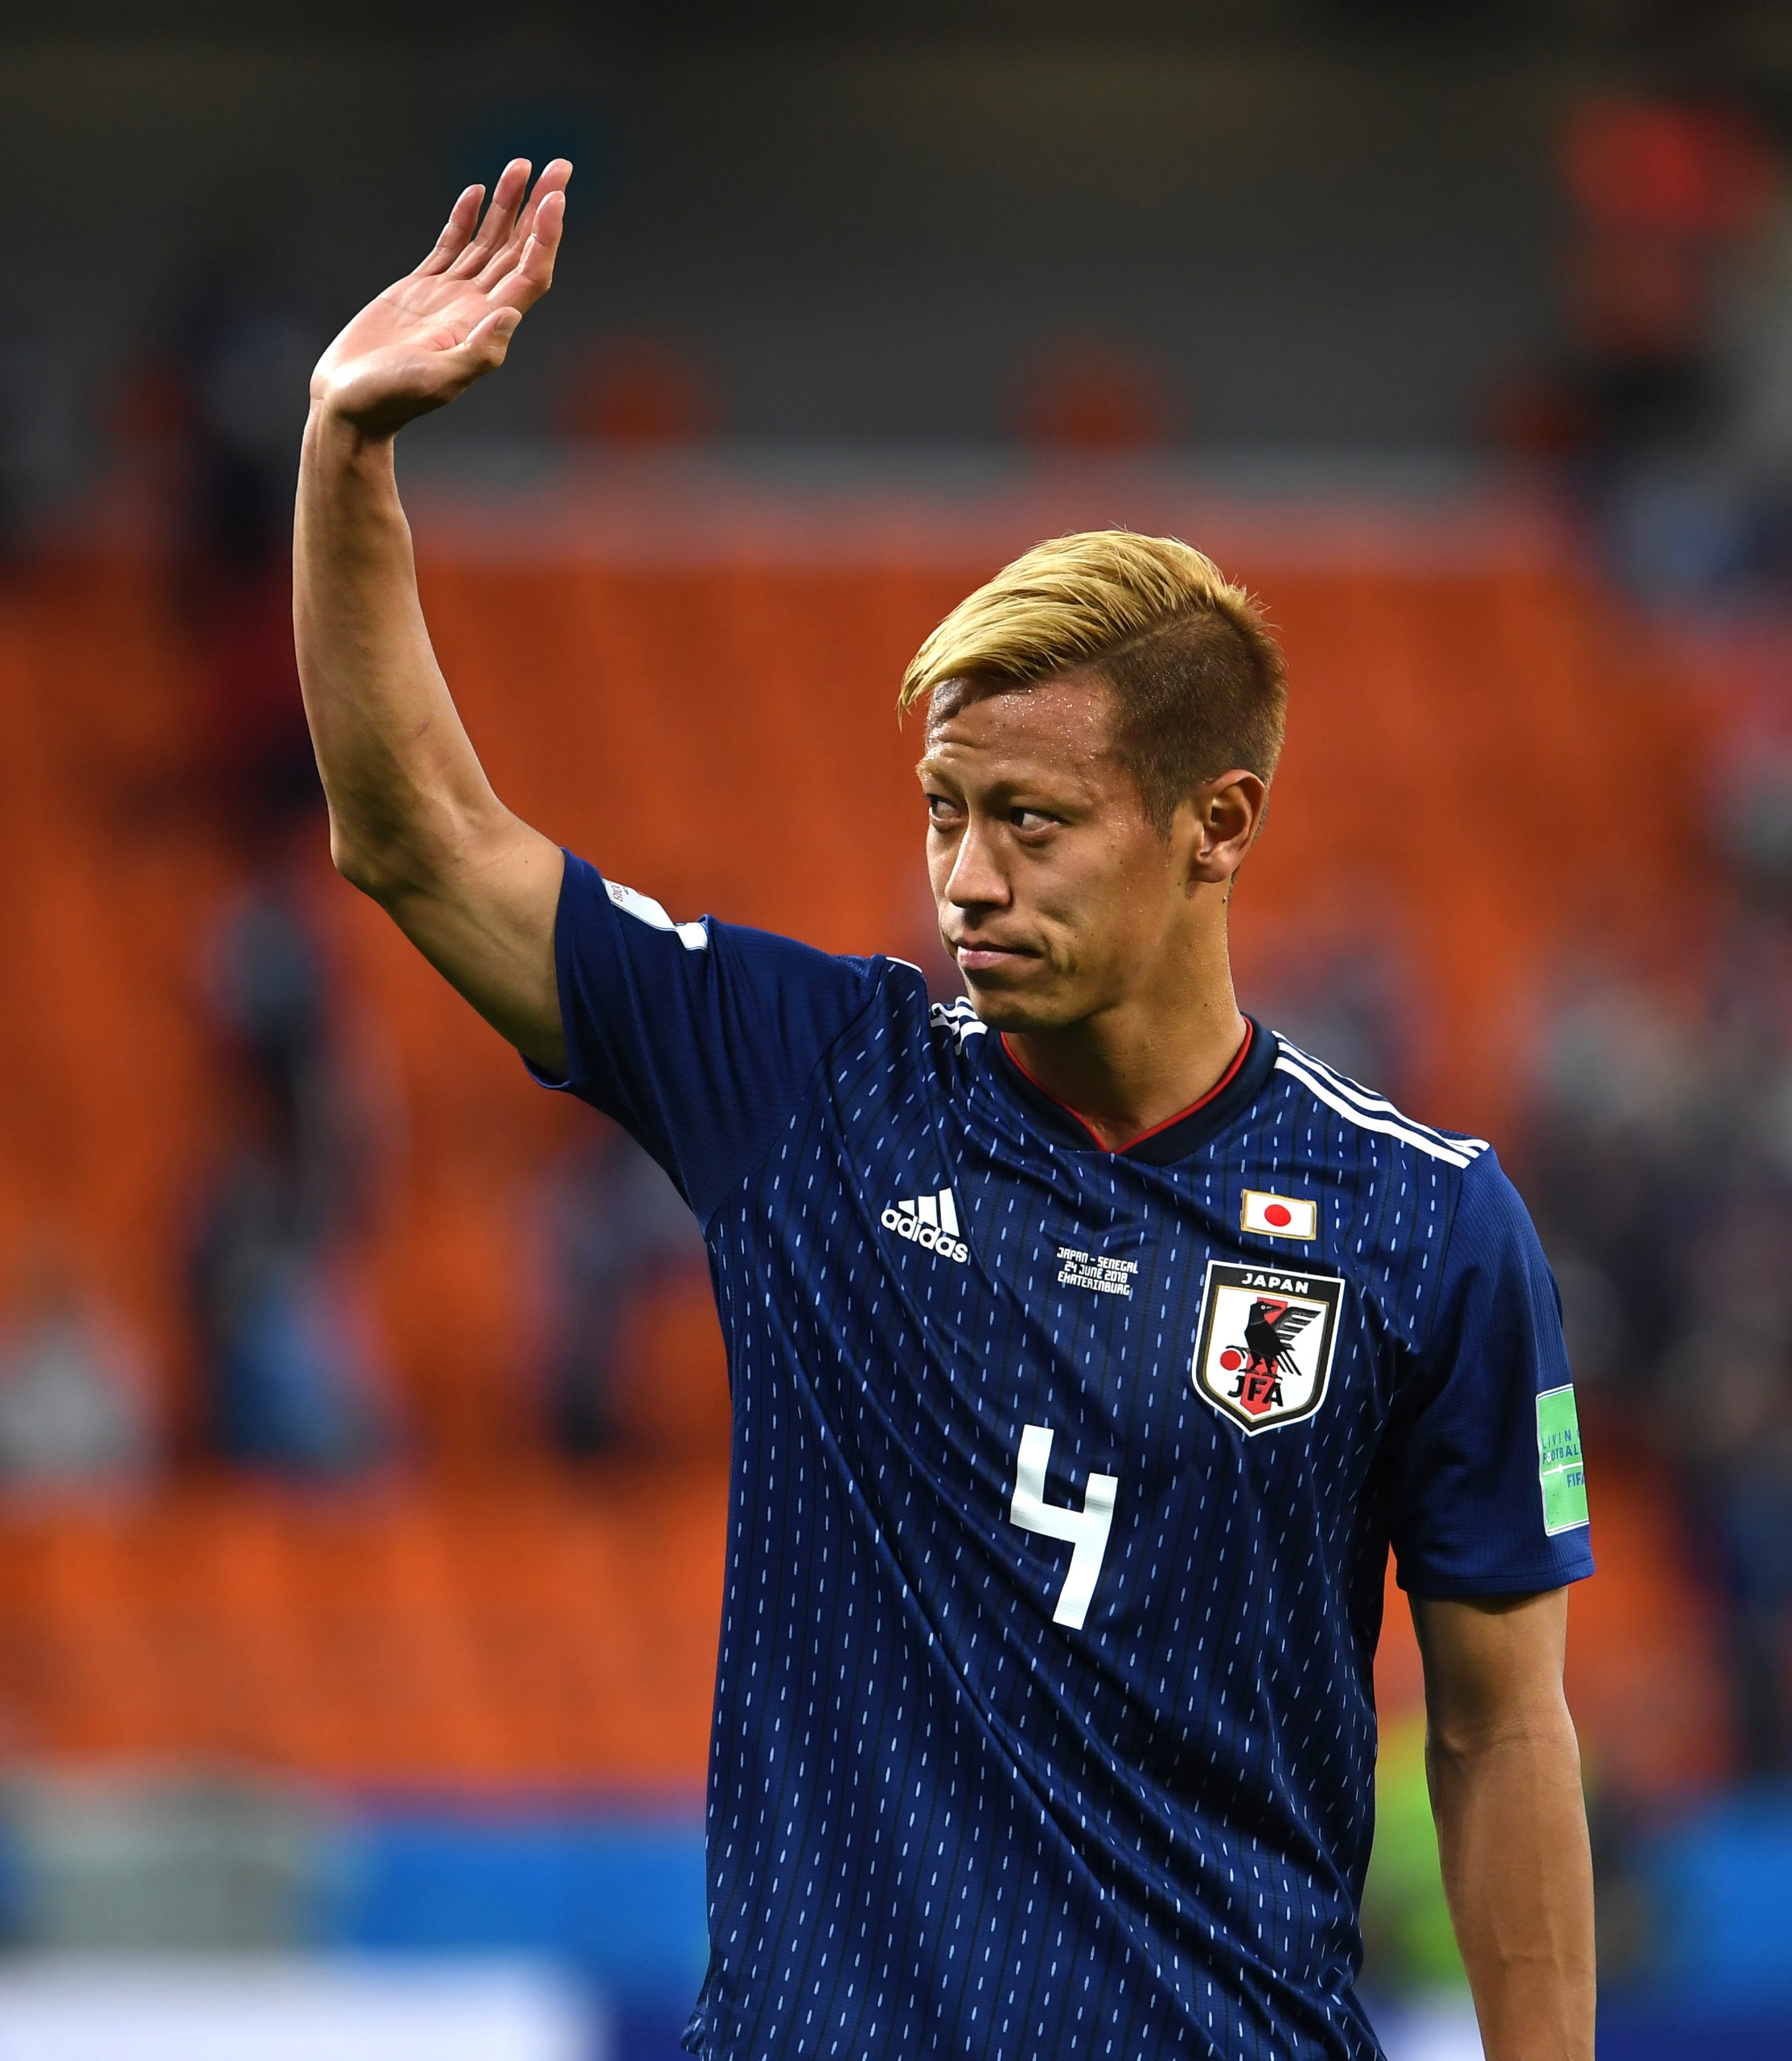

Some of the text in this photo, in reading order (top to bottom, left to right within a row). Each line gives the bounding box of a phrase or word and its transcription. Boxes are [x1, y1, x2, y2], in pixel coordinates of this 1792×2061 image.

[609, 882, 624, 903] 018
[881, 1209, 968, 1263] adidas
[1057, 1246, 1089, 1264] JAPAN
[1097, 1255, 1139, 1274] SENEGAL
[1064, 1260, 1128, 1283] 24 JUNE 2018
[1057, 1271, 1131, 1296] EKATERINBURG
[1241, 1273, 1309, 1294] JAPAN
[1227, 1374, 1284, 1407] JFA
[1543, 1443, 1579, 1464] FOOTBAL
[1010, 1424, 1119, 1631] 4
